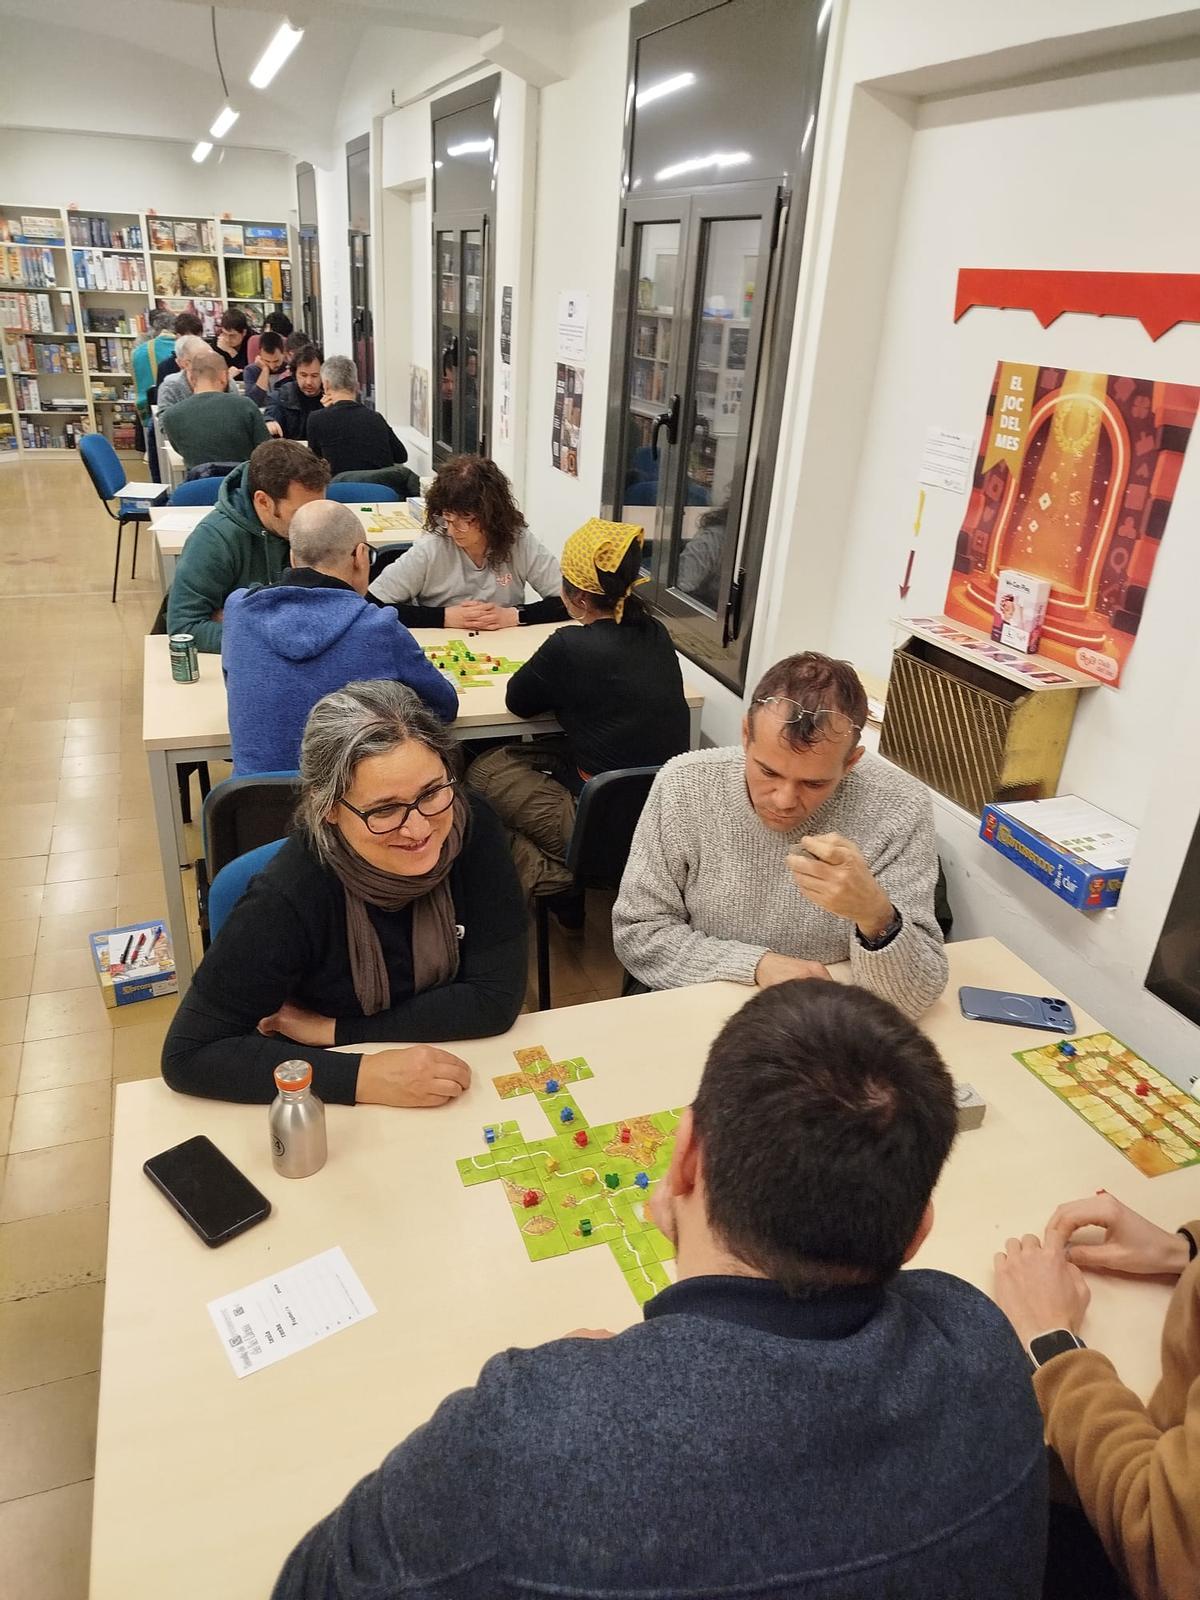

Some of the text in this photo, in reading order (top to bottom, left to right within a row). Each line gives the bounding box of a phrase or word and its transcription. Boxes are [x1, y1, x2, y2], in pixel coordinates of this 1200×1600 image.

[1009, 375, 1023, 391] EL
[1000, 395, 1024, 412] JOC
[1000, 414, 1021, 431] DEL
[995, 433, 1020, 451] MES
